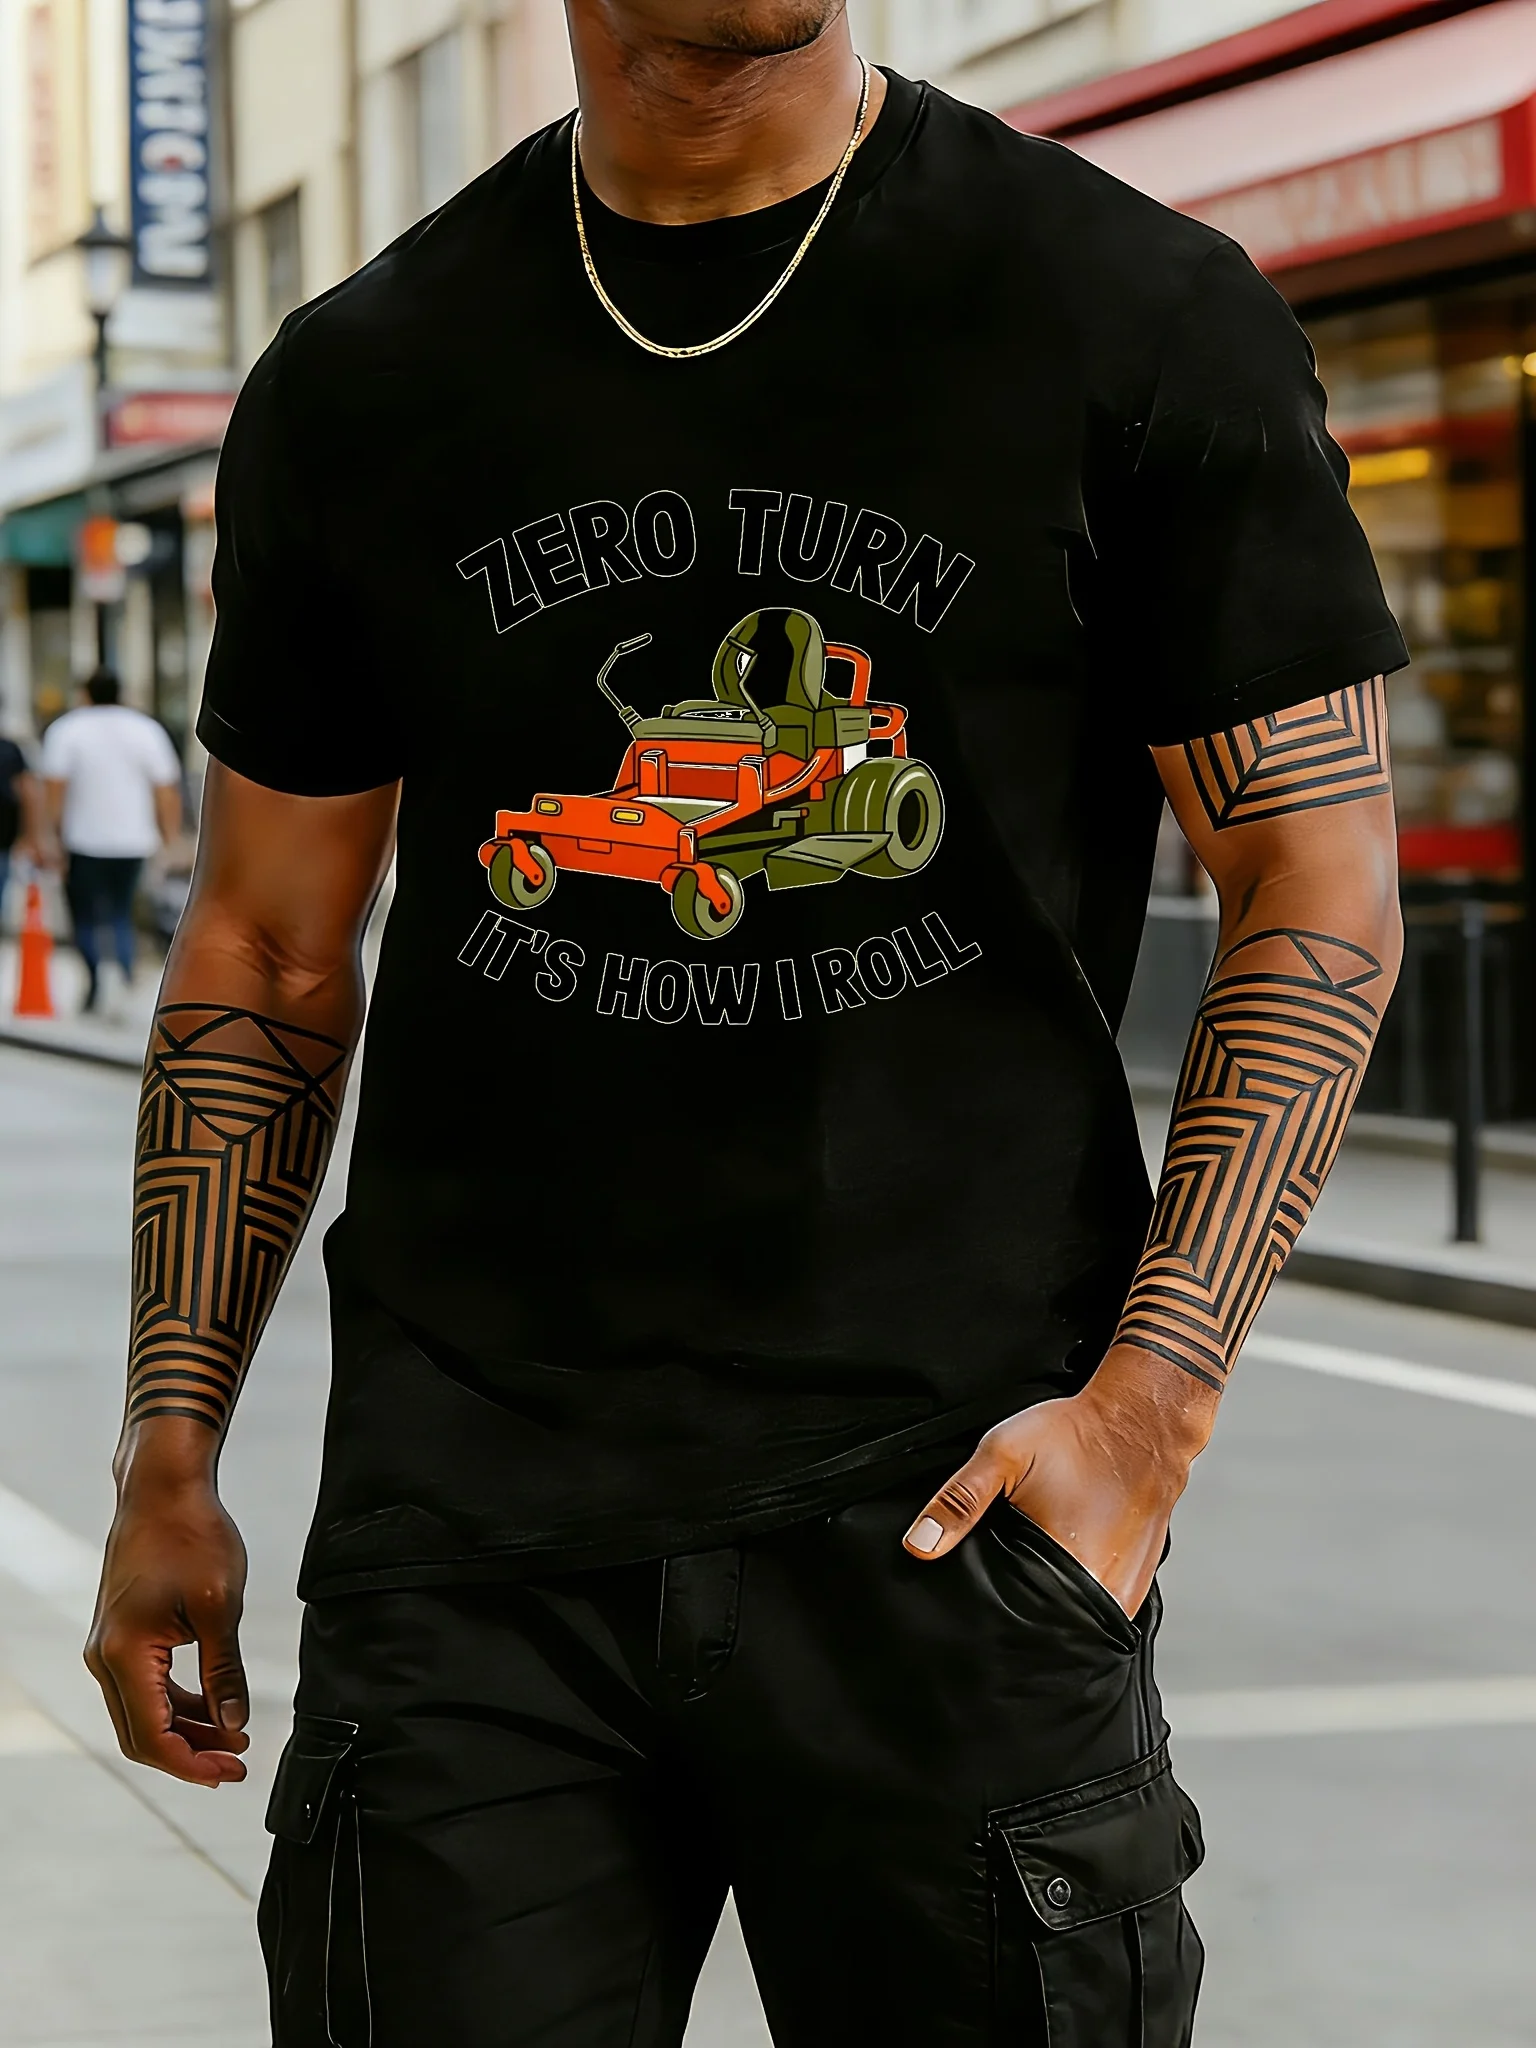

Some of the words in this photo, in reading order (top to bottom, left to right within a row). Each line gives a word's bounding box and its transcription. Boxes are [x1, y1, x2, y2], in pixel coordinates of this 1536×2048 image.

[456, 489, 697, 635] ZERO
[728, 488, 976, 634] TURN
[456, 909, 586, 1003] IT'S
[595, 952, 761, 1026] HOW
[775, 958, 803, 1021] I
[812, 911, 983, 1014] ROLL
